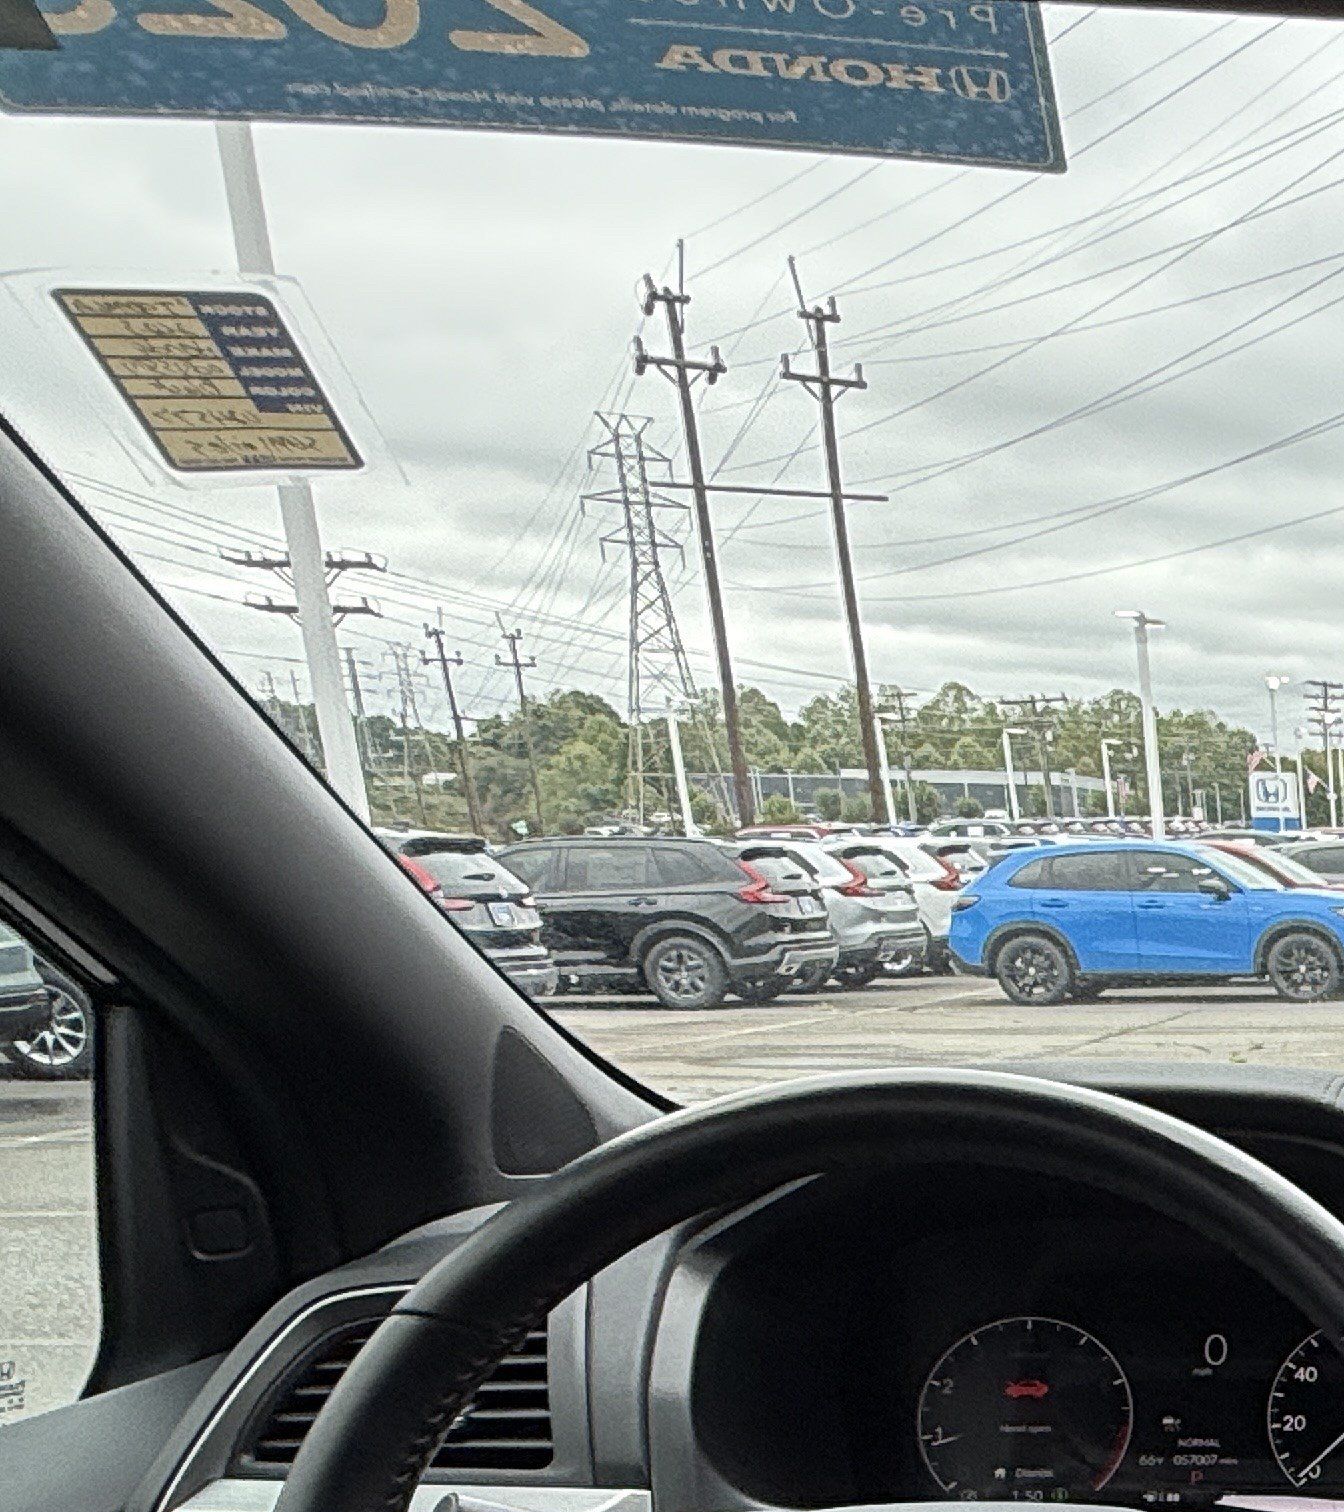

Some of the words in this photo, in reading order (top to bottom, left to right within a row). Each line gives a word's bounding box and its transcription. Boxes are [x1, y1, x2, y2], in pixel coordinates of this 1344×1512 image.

[1204, 1333, 1228, 1366] 0
[1294, 1366, 1318, 1383] 40
[940, 1378, 954, 1394] 2
[1281, 1415, 1306, 1431] 20
[1190, 1470, 1204, 1485] P
